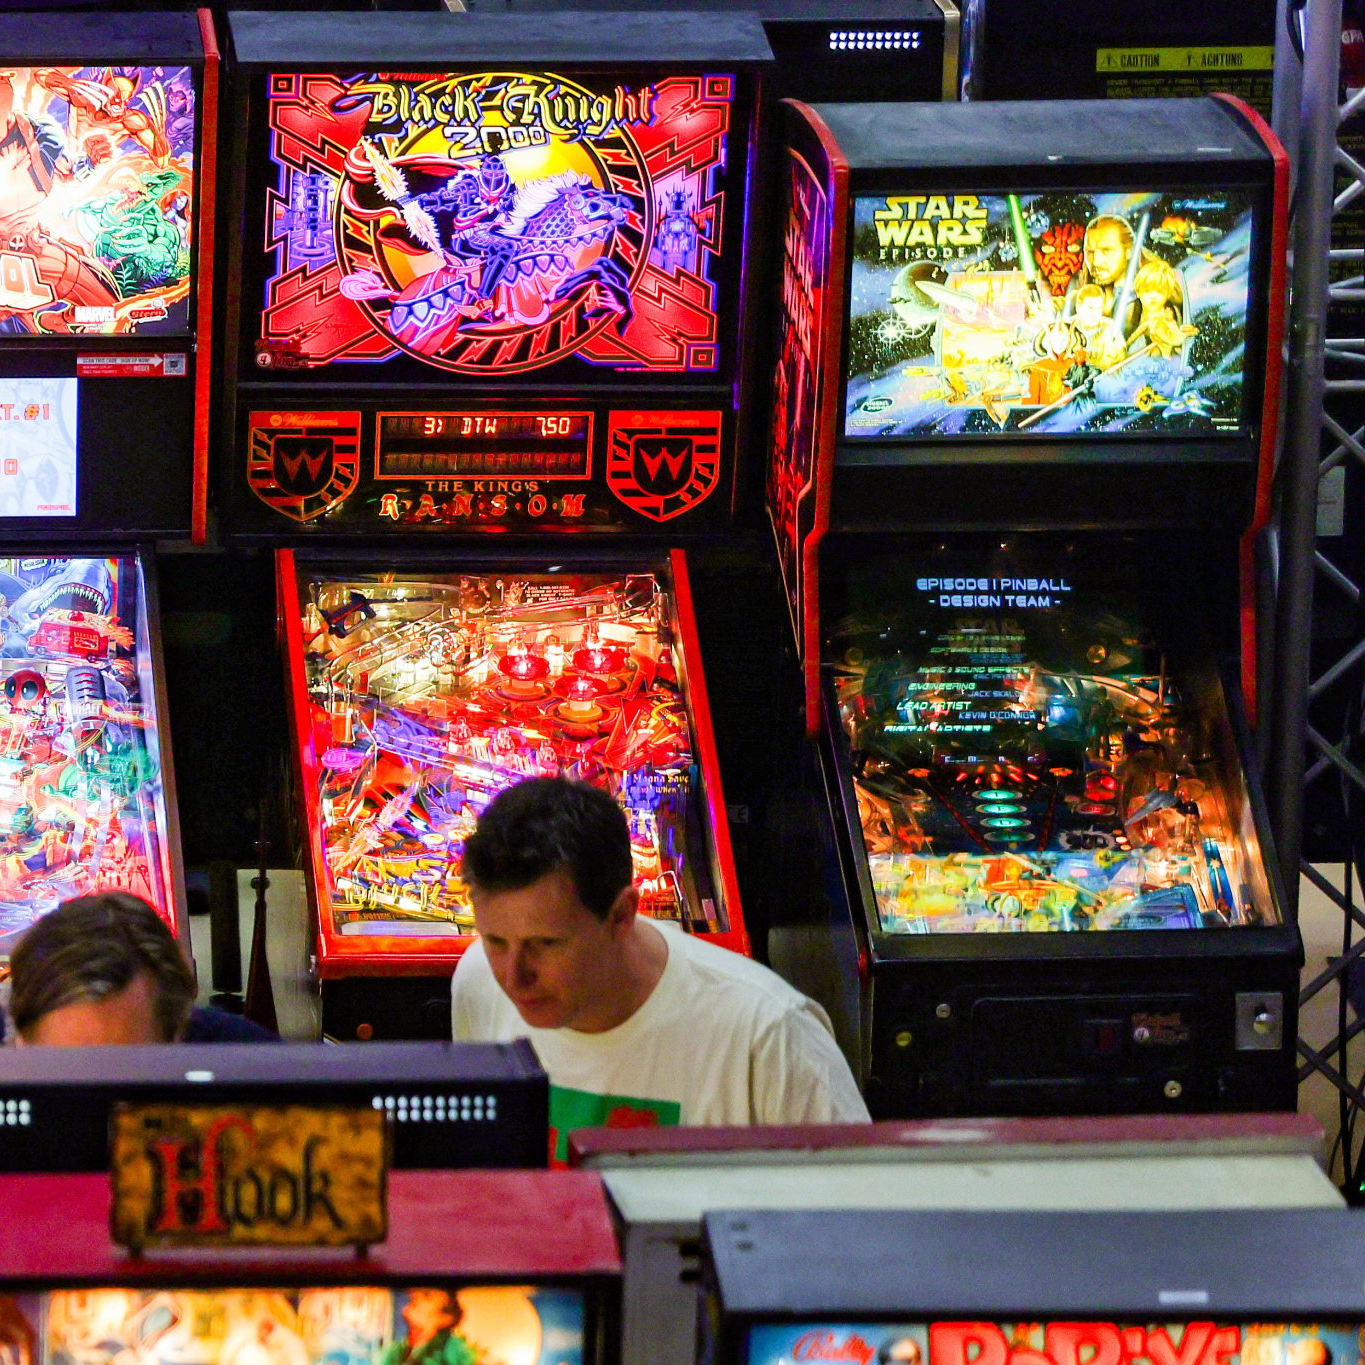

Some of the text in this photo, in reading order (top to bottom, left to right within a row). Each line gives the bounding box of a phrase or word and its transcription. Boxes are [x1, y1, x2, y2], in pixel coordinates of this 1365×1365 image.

[1120, 53, 1160, 68] CAUTION
[1200, 52, 1243, 67] ACHTUNG
[366, 80, 656, 136] Black Knight
[443, 123, 548, 158] 2000
[873, 195, 988, 220] STAR
[874, 219, 987, 247] WARS
[879, 247, 968, 260] EPISODE
[75, 307, 115, 322] MARVEL
[24, 404, 50, 420] #1
[461, 417, 497, 434] DTW
[425, 480, 539, 492] THE KING'S
[916, 578, 989, 590] EPISODE
[1001, 579, 1071, 590] PINBALL
[940, 596, 1050, 606] DESIGN TEAM
[896, 702, 971, 710] LEAD ARTIST
[633, 774, 689, 783] Magna Save
[150, 1115, 343, 1232] Hook
